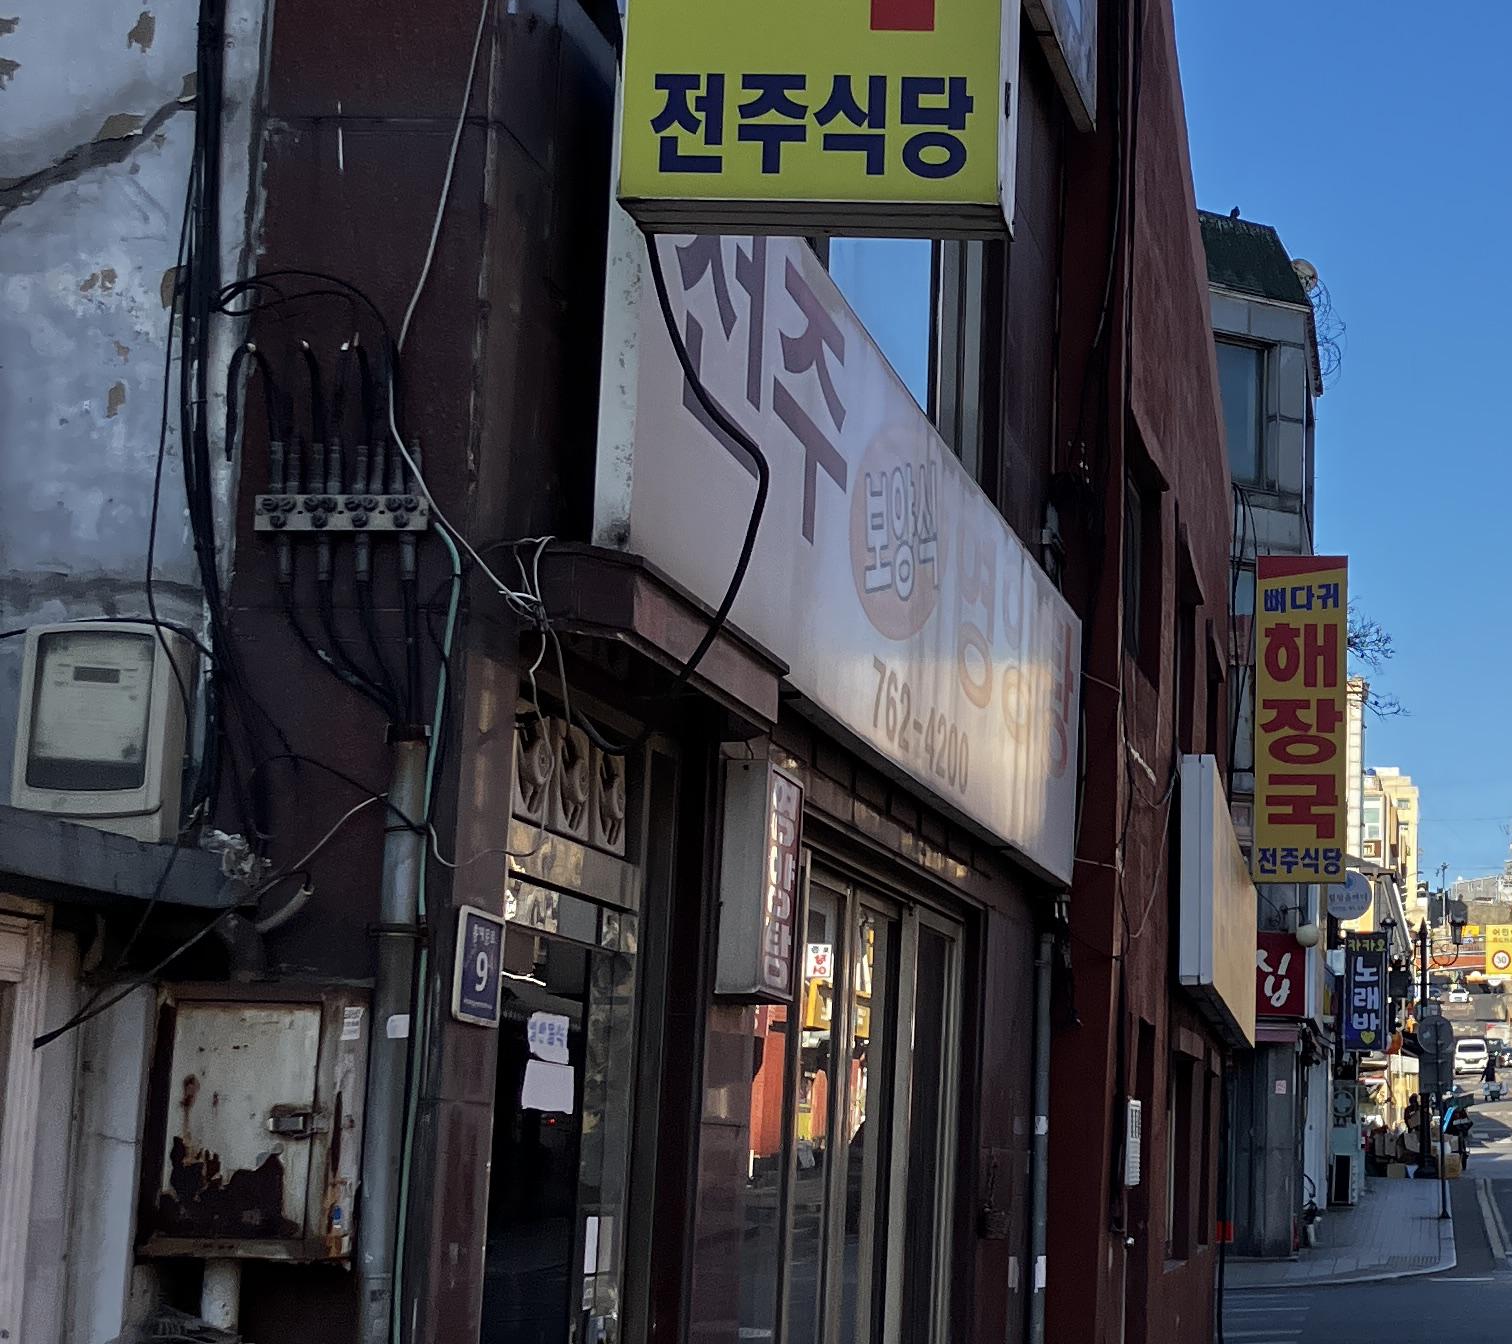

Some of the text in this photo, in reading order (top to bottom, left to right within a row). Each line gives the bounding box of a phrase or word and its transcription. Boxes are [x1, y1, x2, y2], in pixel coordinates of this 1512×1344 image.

[651, 73, 974, 179] 전주식당
[863, 462, 938, 601] 보양식
[1264, 582, 1340, 614] 뼈다귀
[872, 656, 969, 796] 762-4200
[1260, 622, 1343, 840] 해장국
[1258, 847, 1345, 876] 전주식당
[475, 951, 489, 992] 9
[1347, 939, 1387, 952] 카카오
[1496, 956, 1508, 965] 30
[1351, 955, 1380, 1032] 노래바
